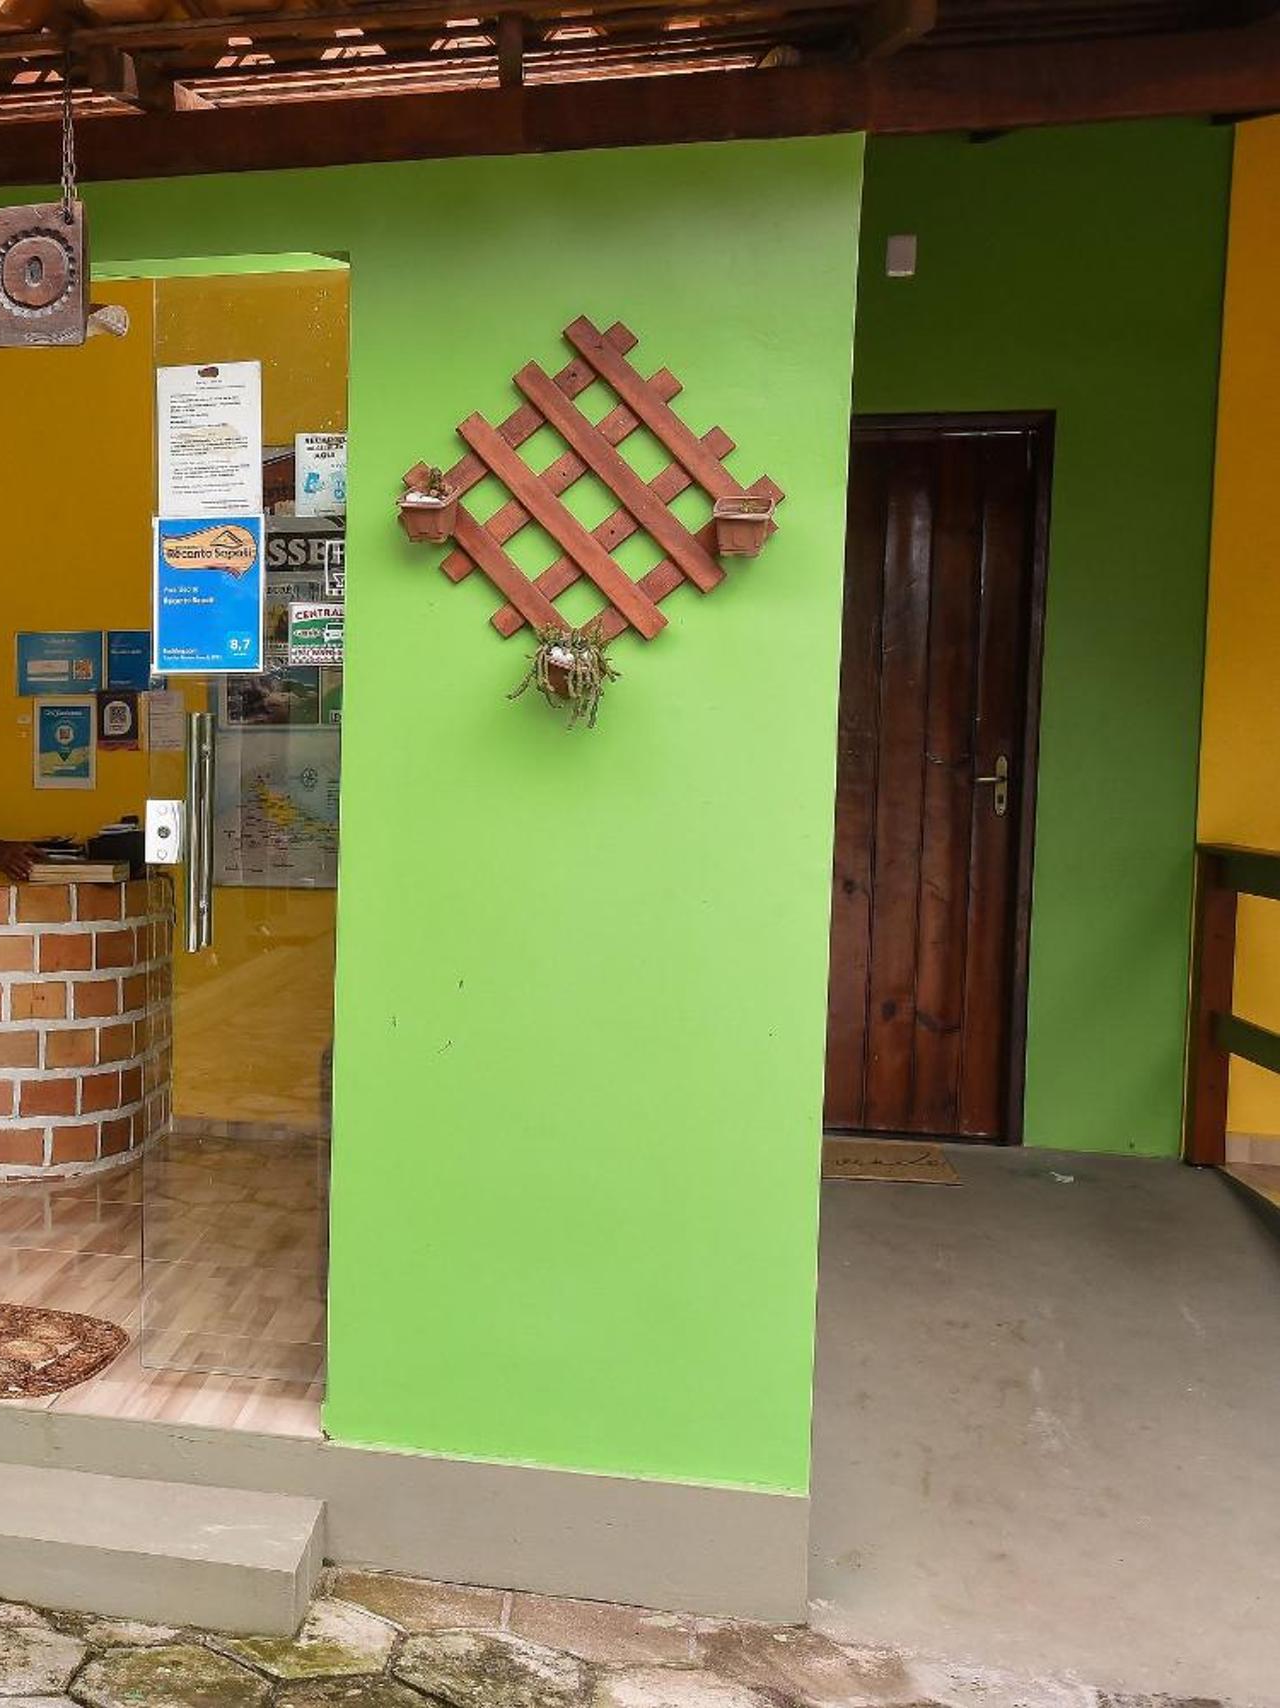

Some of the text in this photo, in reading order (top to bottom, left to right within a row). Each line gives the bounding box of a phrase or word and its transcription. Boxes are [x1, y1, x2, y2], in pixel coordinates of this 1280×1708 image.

[167, 548, 213, 559] Recanto
[294, 607, 345, 621] CENTRAL
[229, 638, 251, 652] 8,7
